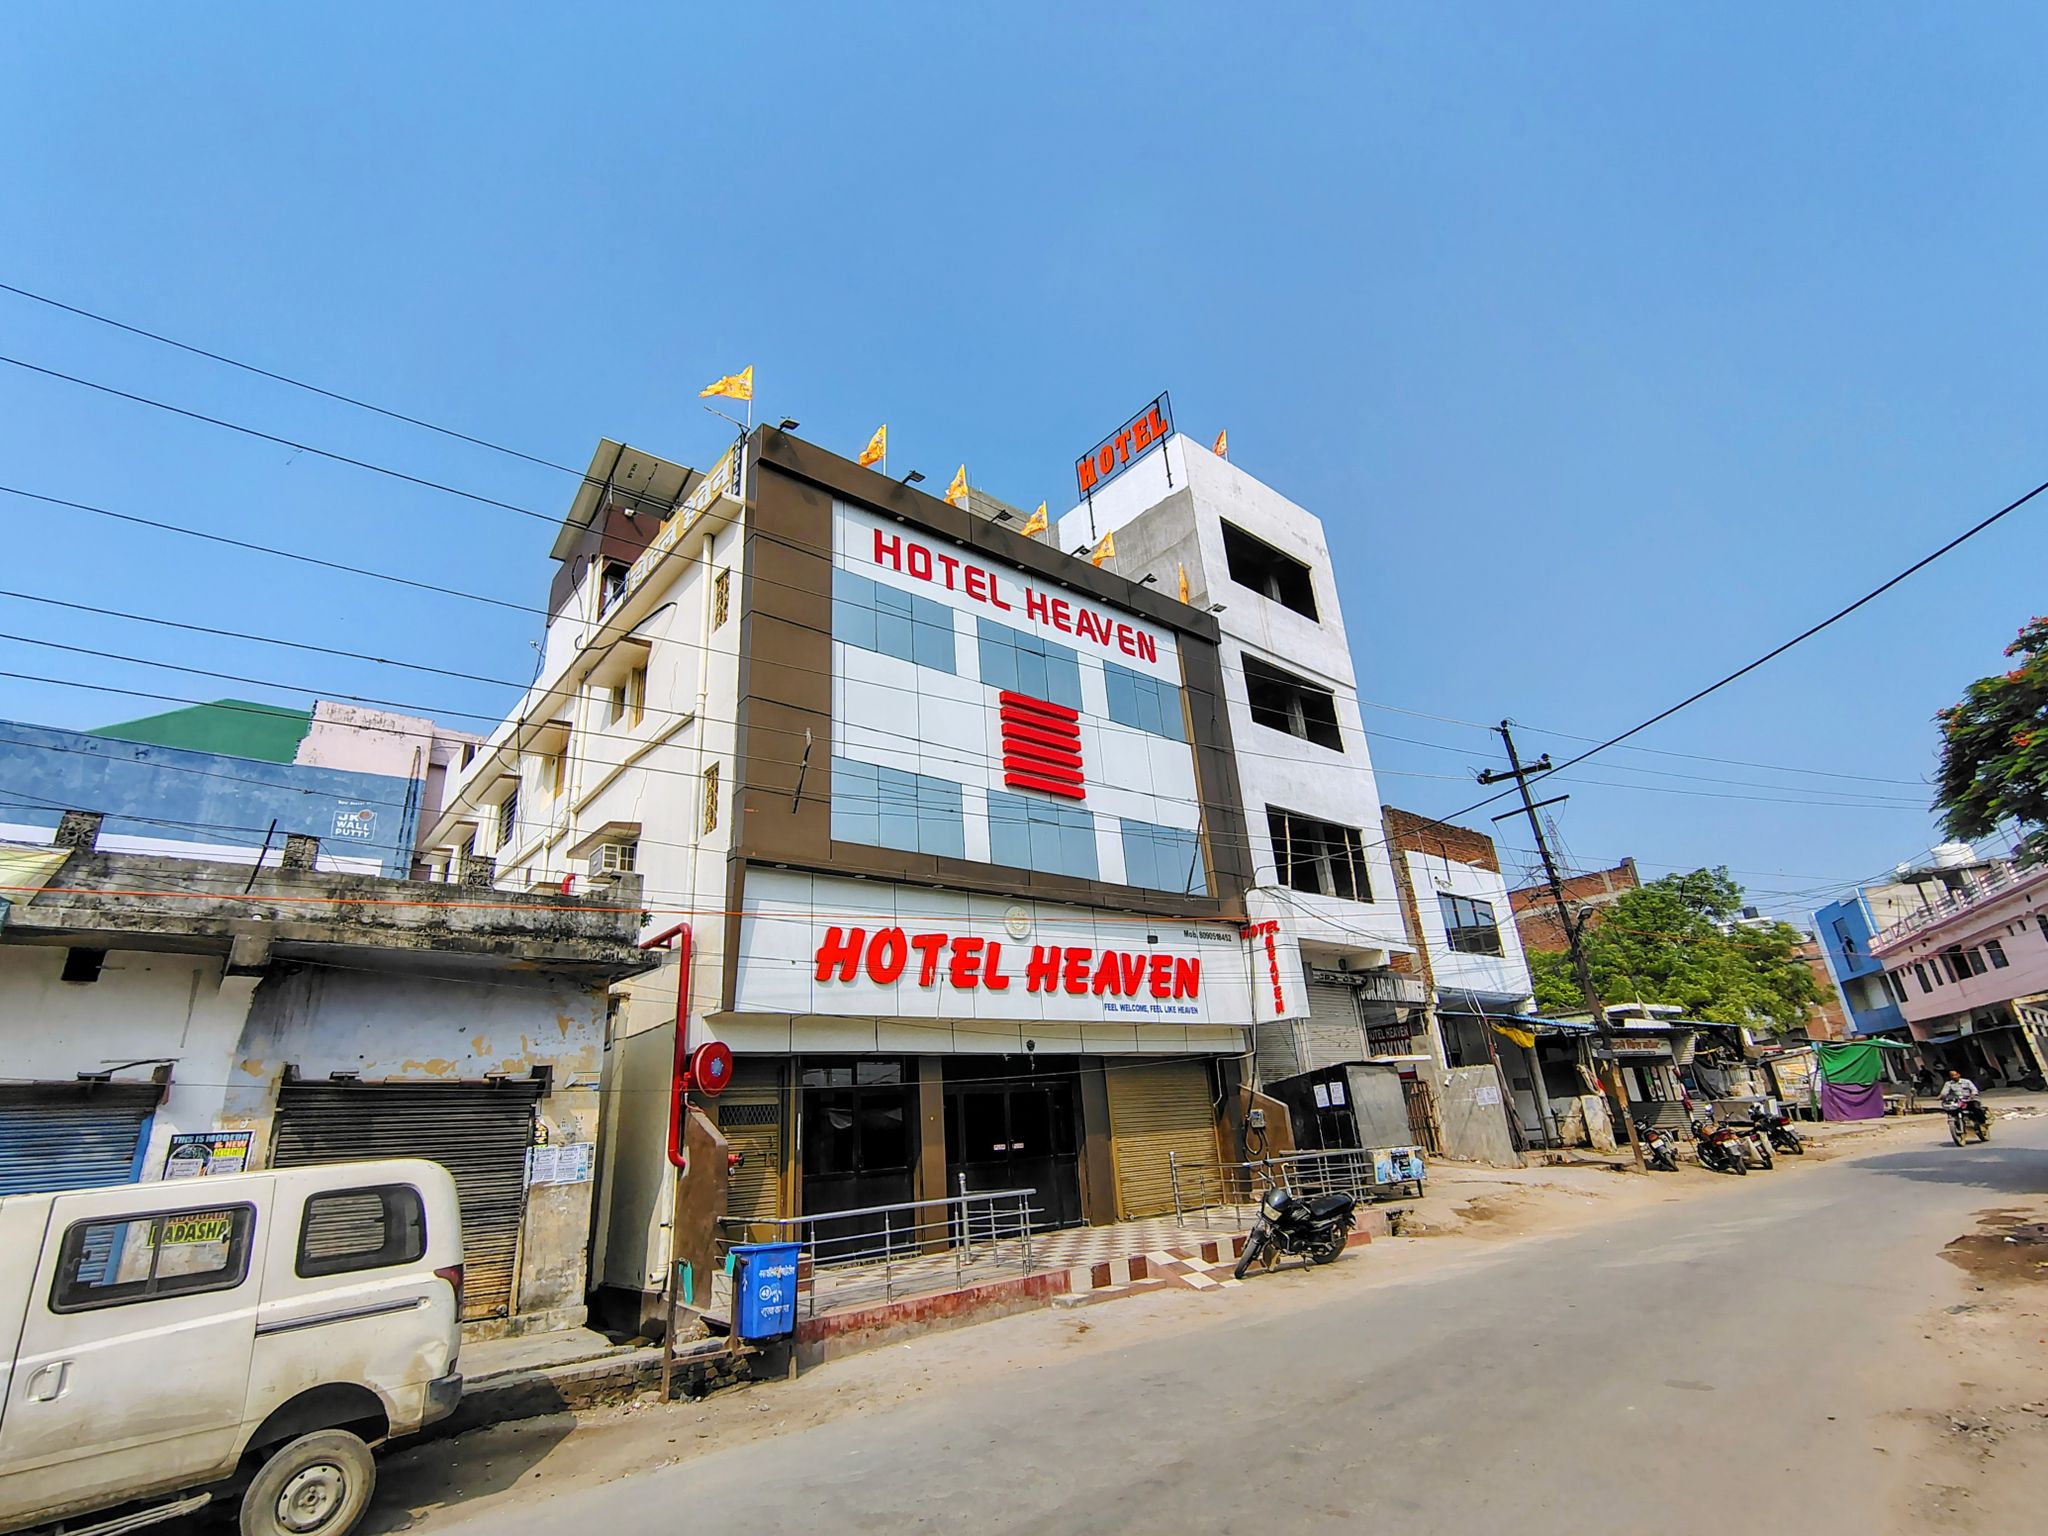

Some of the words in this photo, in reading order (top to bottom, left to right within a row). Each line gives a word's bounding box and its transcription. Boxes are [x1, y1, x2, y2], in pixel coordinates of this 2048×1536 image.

[1078, 407, 1168, 492] HOTEL
[873, 527, 1012, 612] HOTEL
[1025, 586, 1158, 664] HEAVEN
[334, 827, 370, 838] PUTTY
[336, 820, 370, 831] WALL
[1239, 919, 1280, 940] HOTEL
[814, 926, 1010, 990] HOTEL
[1025, 945, 1200, 999] HEAVEN
[1265, 934, 1284, 1014] HEAVEN
[1104, 1003, 1118, 1012] FEEL
[1120, 1003, 1149, 1014] WELCOME,
[1150, 1004, 1163, 1013] FEEL
[1164, 1006, 1177, 1014] LIKE
[1178, 1006, 1198, 1014] HEAVEN
[173, 1135, 194, 1144] THIS
[195, 1135, 204, 1143] IS
[205, 1133, 249, 1143] MODERN
[225, 1140, 247, 1148] NEW
